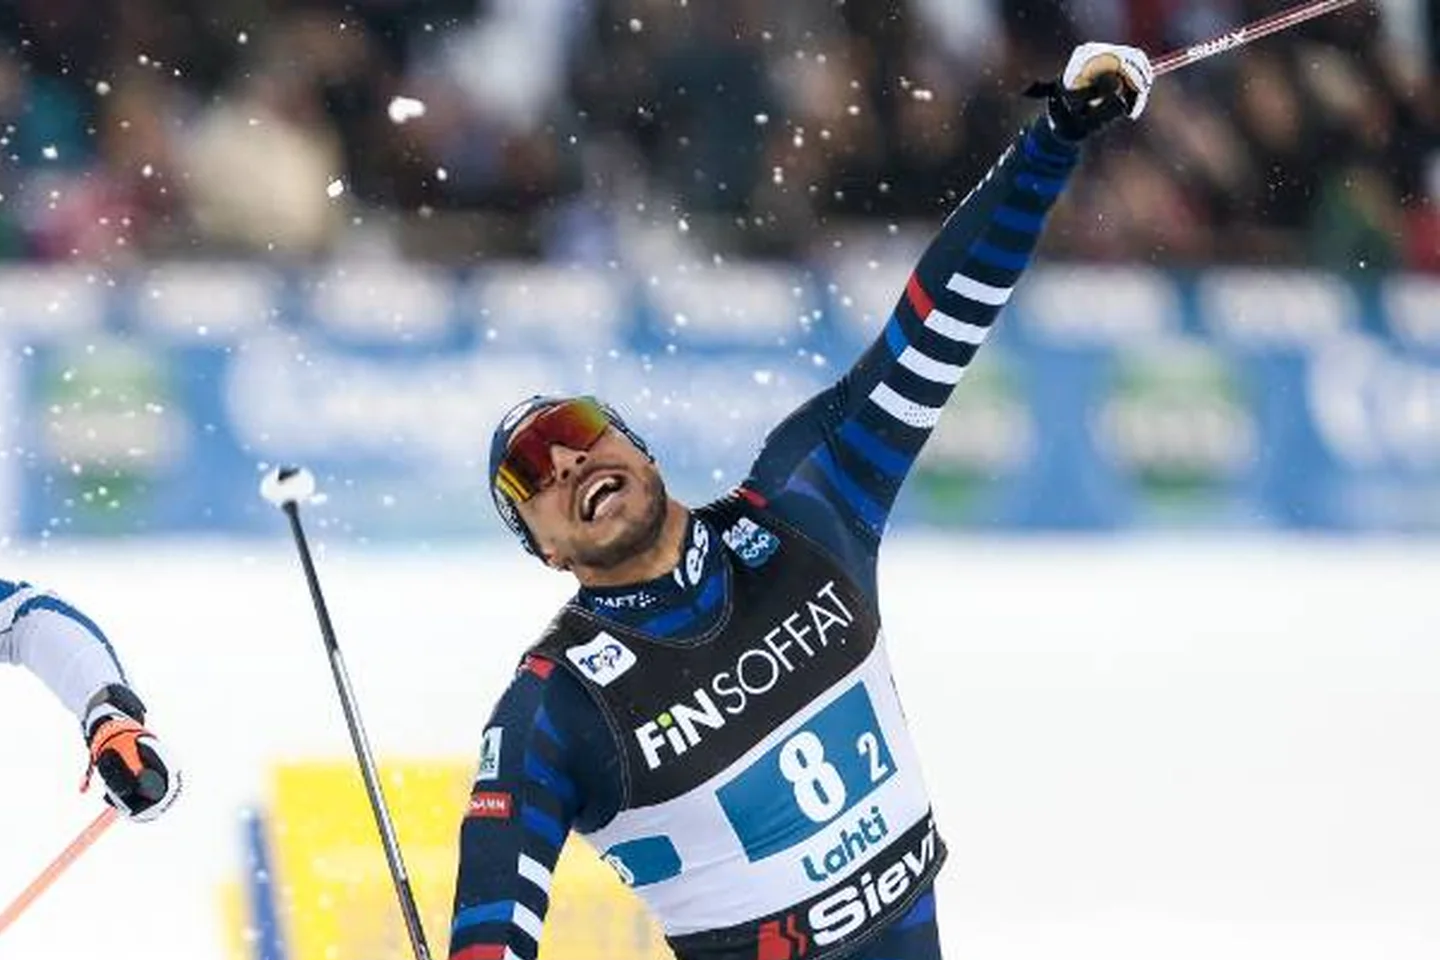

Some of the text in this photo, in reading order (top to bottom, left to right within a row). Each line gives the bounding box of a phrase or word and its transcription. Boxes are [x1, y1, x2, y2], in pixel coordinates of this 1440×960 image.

[778, 730, 890, 822] 8 2
[800, 804, 890, 883] Lahti
[806, 820, 939, 947] Sievi
